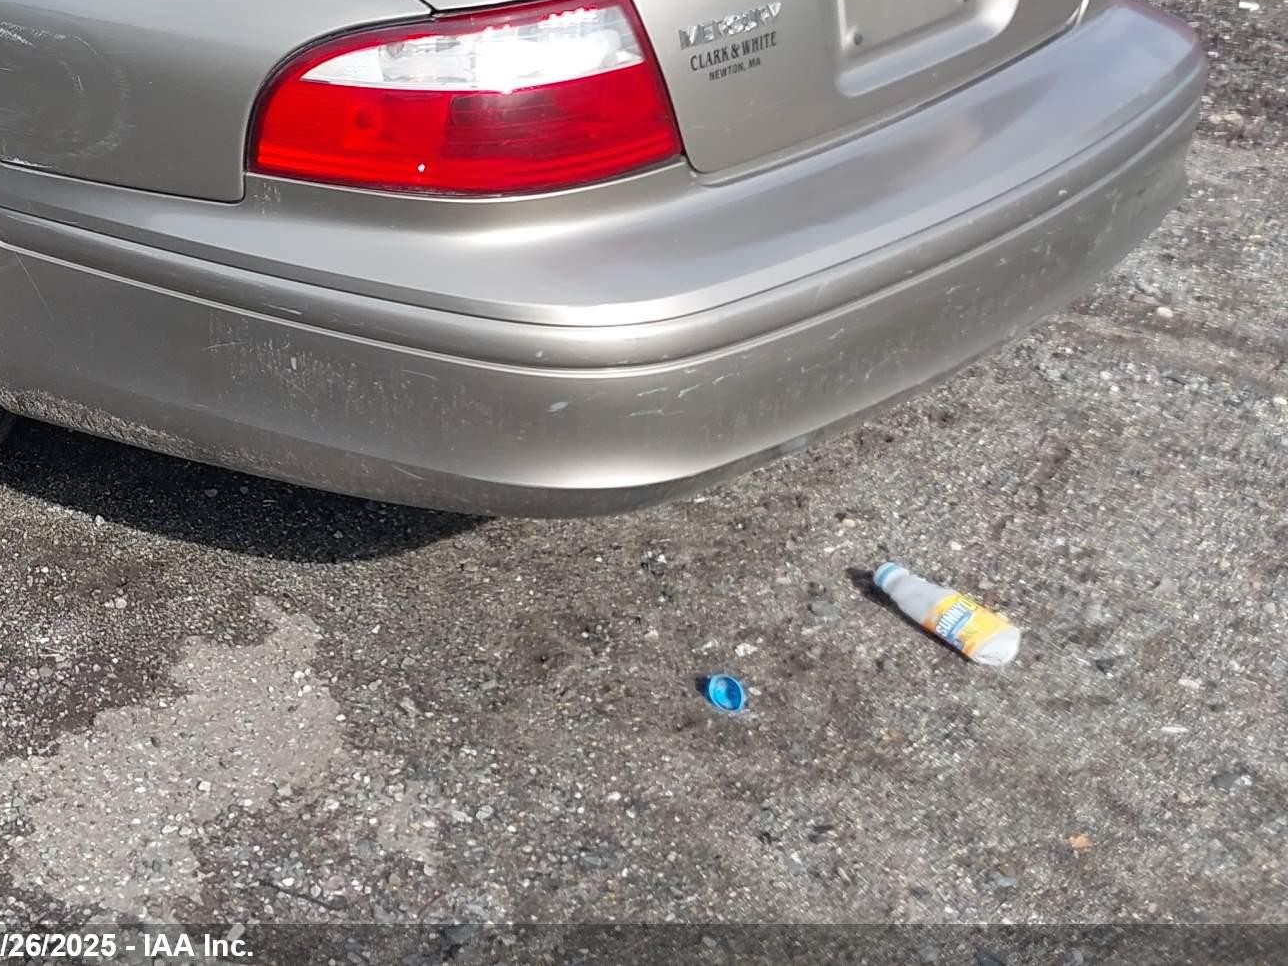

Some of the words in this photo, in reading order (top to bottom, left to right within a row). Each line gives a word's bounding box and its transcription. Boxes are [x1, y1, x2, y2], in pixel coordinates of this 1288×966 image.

[690, 45, 729, 72] CLARK
[730, 43, 741, 60] &
[741, 31, 777, 56] WHITE
[748, 57, 761, 70] MA
